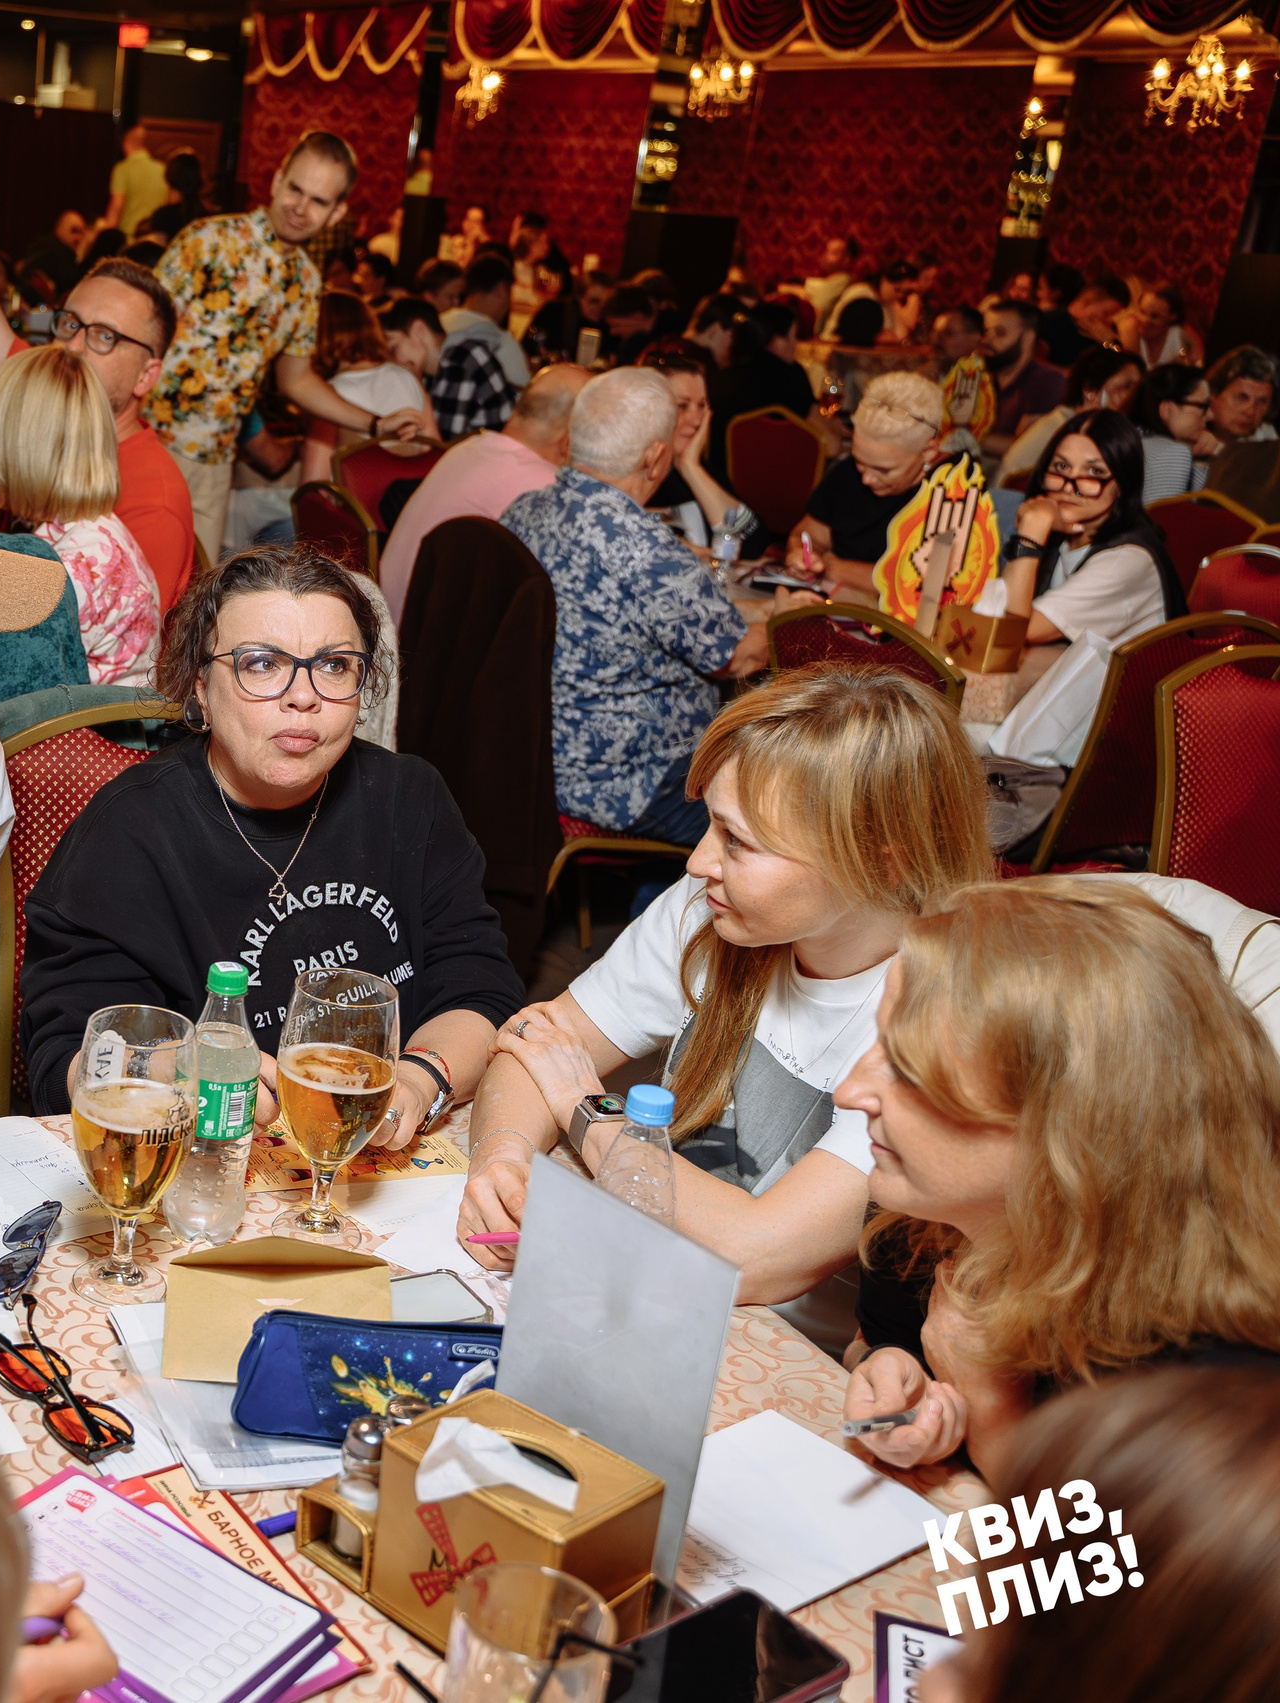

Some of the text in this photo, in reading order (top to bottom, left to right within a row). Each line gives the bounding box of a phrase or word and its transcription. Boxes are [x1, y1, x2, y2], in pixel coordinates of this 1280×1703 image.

[239, 881, 399, 987] KARL LAGERFELD
[292, 940, 359, 977] PARIS
[254, 1010, 272, 1029] 21
[207, 1510, 265, 1569] БАРНОЕ
